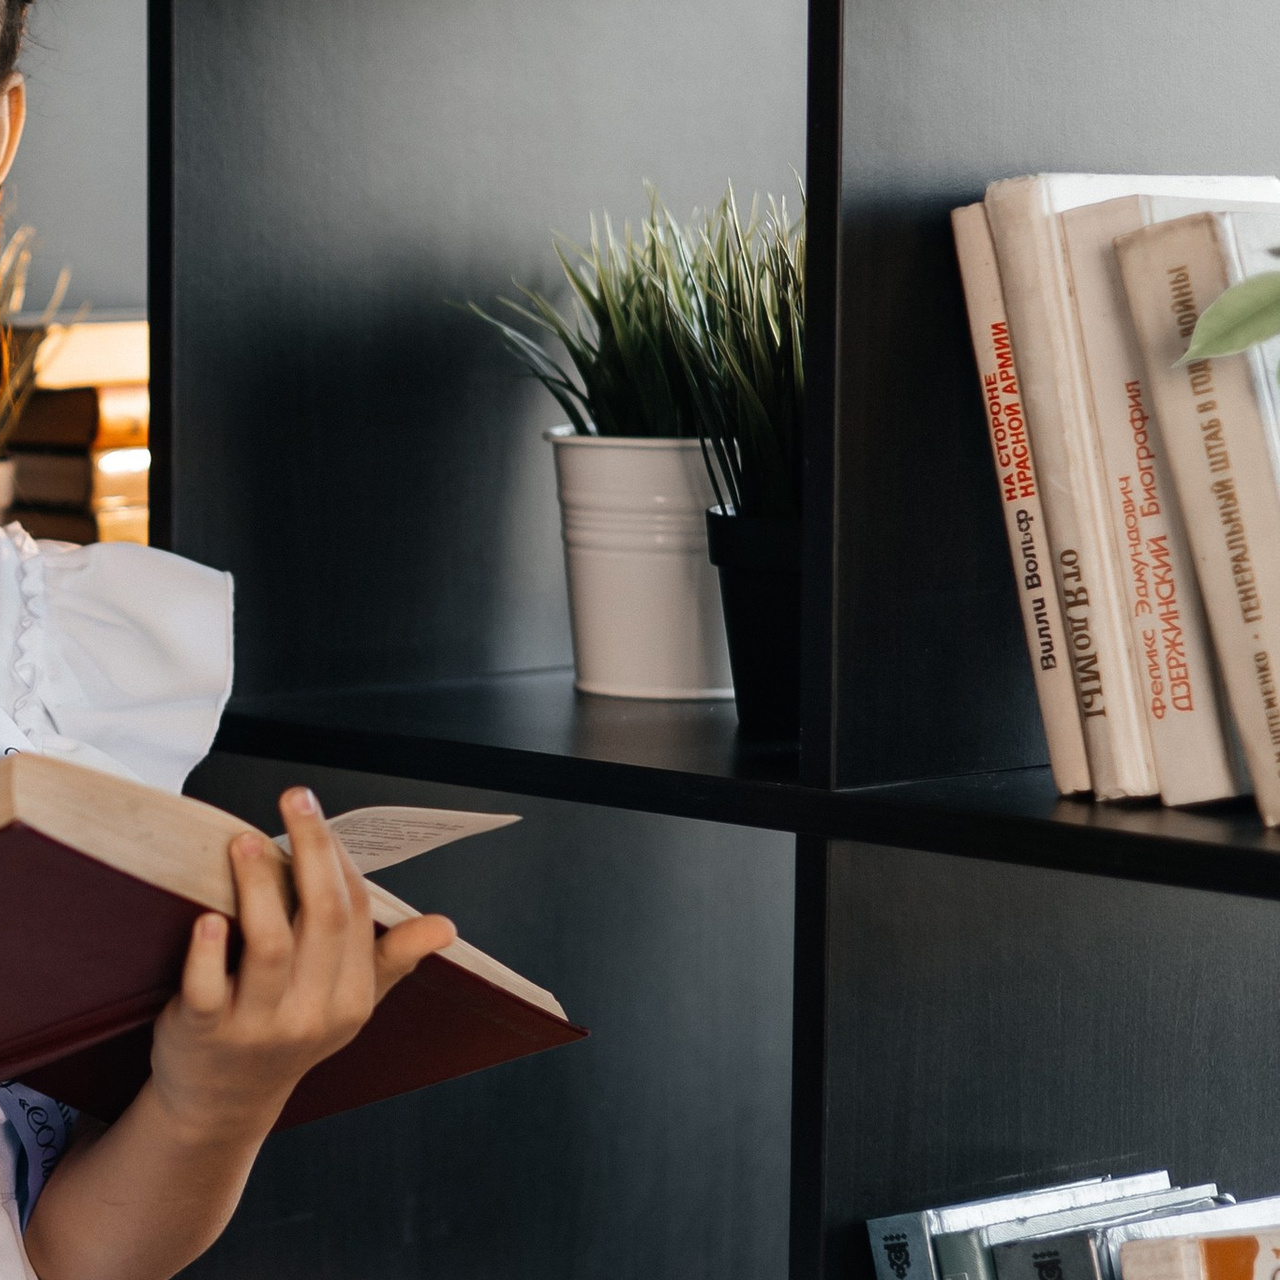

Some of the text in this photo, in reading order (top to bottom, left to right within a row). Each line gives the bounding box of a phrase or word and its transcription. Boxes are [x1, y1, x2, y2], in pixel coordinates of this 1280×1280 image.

[983, 372, 1018, 502] НА СТОРОНЕ
[990, 320, 1036, 498] КРАСНОЙ АРМИИ
[1187, 353, 1214, 397] ГОД
[1195, 399, 1218, 415] В
[1200, 418, 1231, 473] ШТАБ
[1016, 508, 1057, 671] Вилли Вольф
[1119, 475, 1167, 720] Феликс Эдмундович
[1124, 379, 1194, 712] ДЗЕРЖИНСКИЙ Биография
[1210, 477, 1263, 624] ГЕНЕРАЛЬНЫЙ
